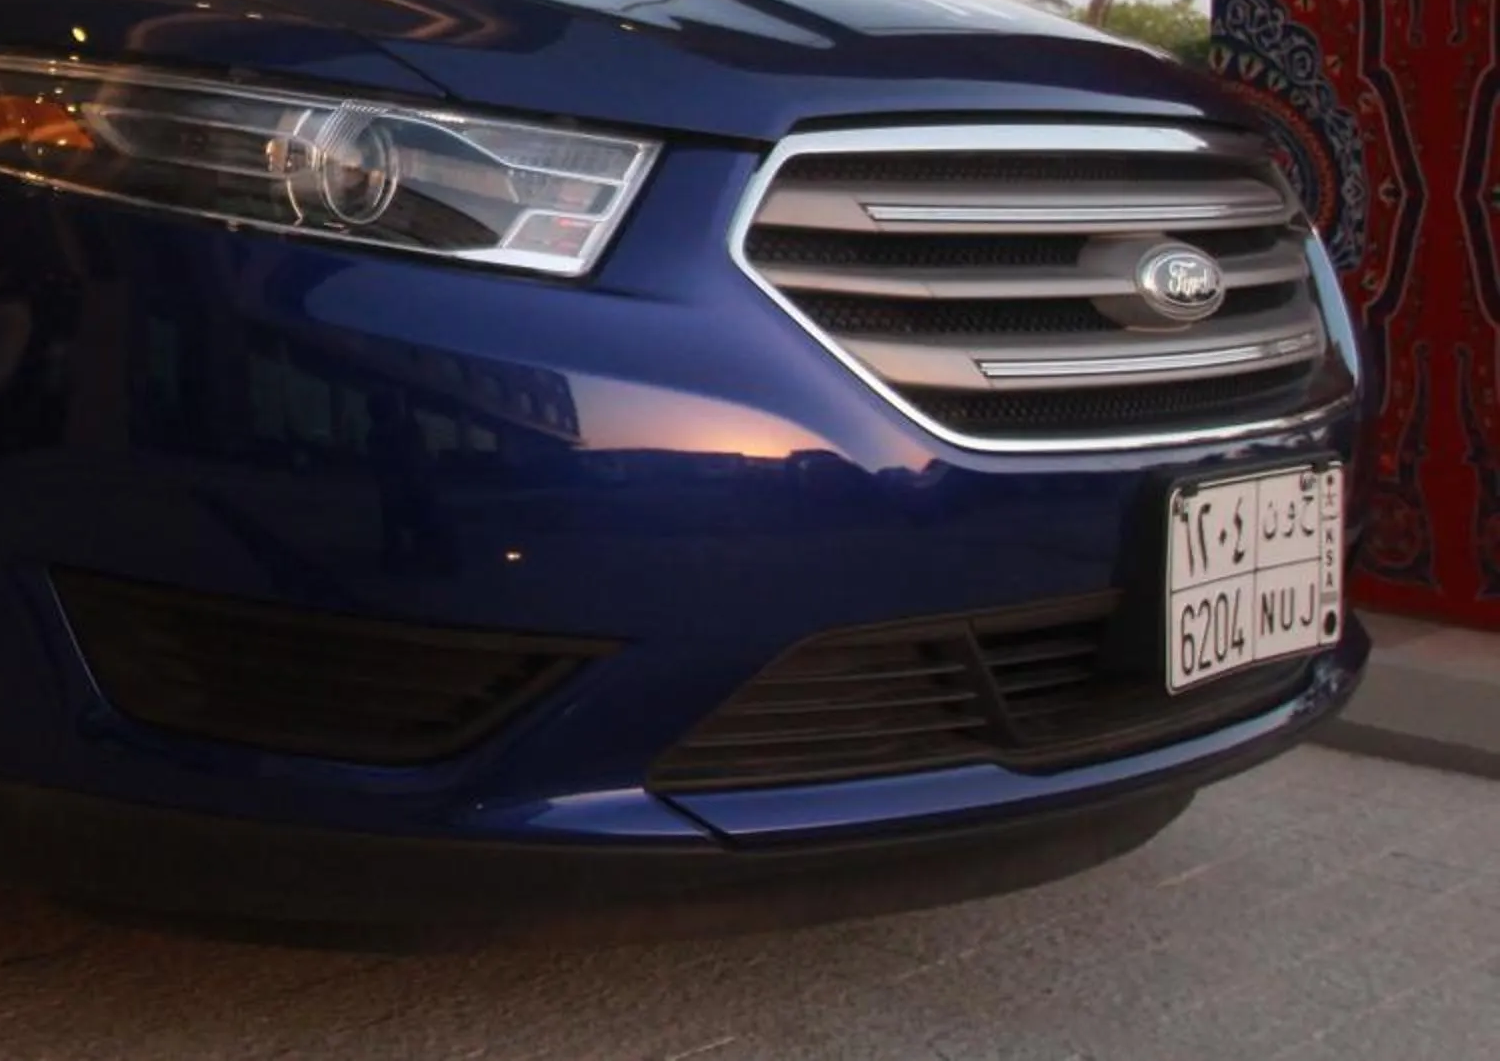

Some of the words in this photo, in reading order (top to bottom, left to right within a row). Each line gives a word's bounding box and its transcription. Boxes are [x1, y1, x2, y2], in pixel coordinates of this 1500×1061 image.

[1168, 259, 1216, 297] Ford
[1180, 587, 1245, 676] 6204
[1260, 583, 1316, 636] NUJ
